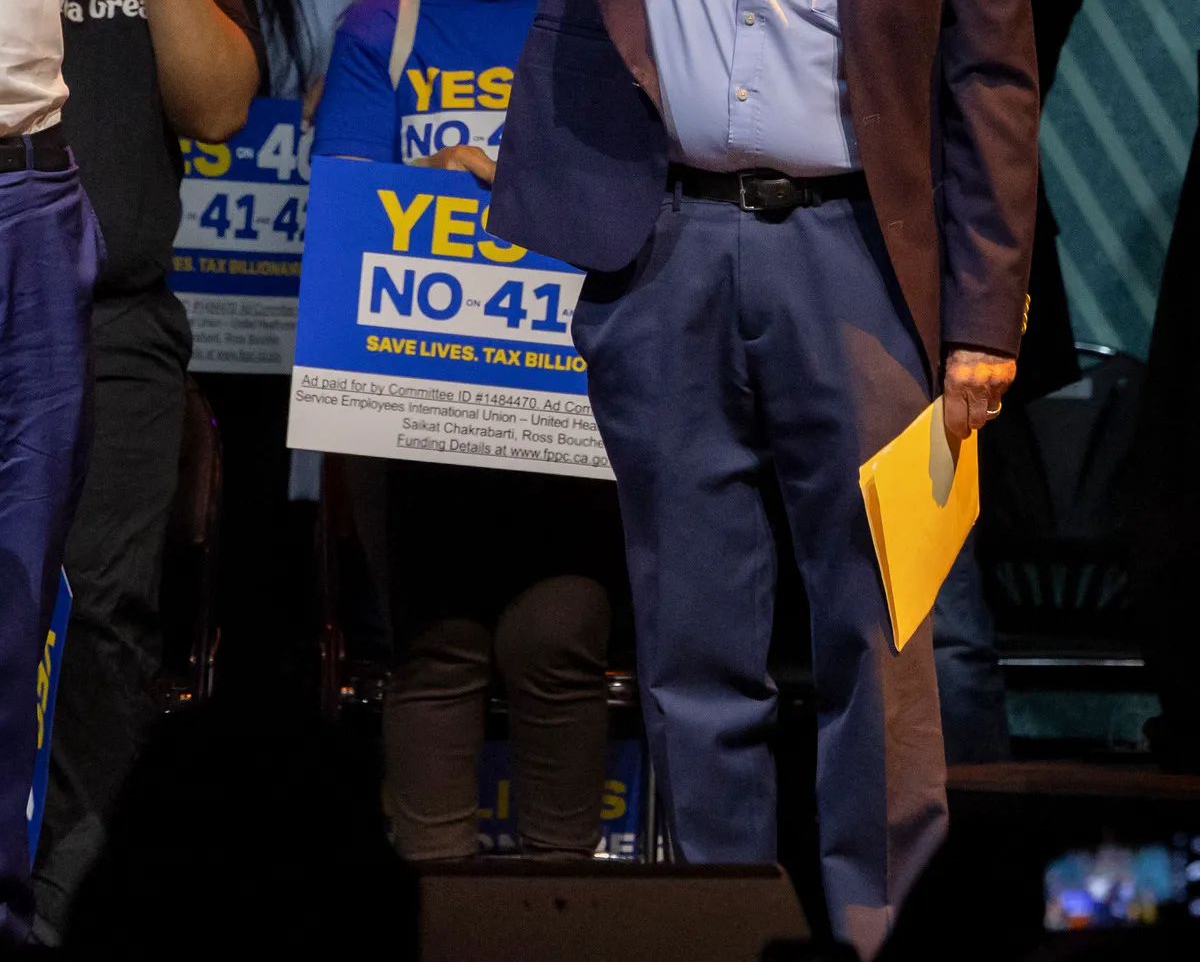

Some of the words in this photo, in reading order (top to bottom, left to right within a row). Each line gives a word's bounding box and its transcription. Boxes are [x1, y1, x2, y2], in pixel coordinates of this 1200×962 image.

[406, 65, 514, 112] YES
[406, 120, 470, 159] NO
[200, 193, 259, 240] 41
[273, 196, 307, 242] 4
[369, 265, 463, 322] NO
[465, 299, 481, 308] ON
[484, 280, 568, 333] 41
[366, 335, 417, 356] SAVE
[419, 341, 480, 362] LIVES.
[482, 347, 521, 367] TAX
[524, 352, 588, 373] BILLIO
[295, 389, 338, 406] Service
[341, 394, 405, 413] Employees
[408, 401, 479, 420] International
[482, 409, 517, 424] Union
[530, 413, 569, 429] United
[571, 419, 598, 433] Hea
[301, 374, 319, 388] Ad
[321, 377, 348, 391] paid
[350, 379, 368, 393] for
[370, 381, 386, 396] by
[388, 383, 455, 401] Committee
[458, 391, 472, 403] ID
[543, 399, 561, 412] Ad
[564, 401, 593, 415] Com
[396, 433, 446, 453] Funding
[449, 439, 491, 456] Details
[494, 445, 507, 456] at
[510, 447, 609, 469] www.fppc.ca.go
[402, 417, 441, 433] Saikat
[443, 421, 518, 442] Chakrabarti,
[521, 429, 554, 444] Ross
[557, 433, 605, 449] Bouche
